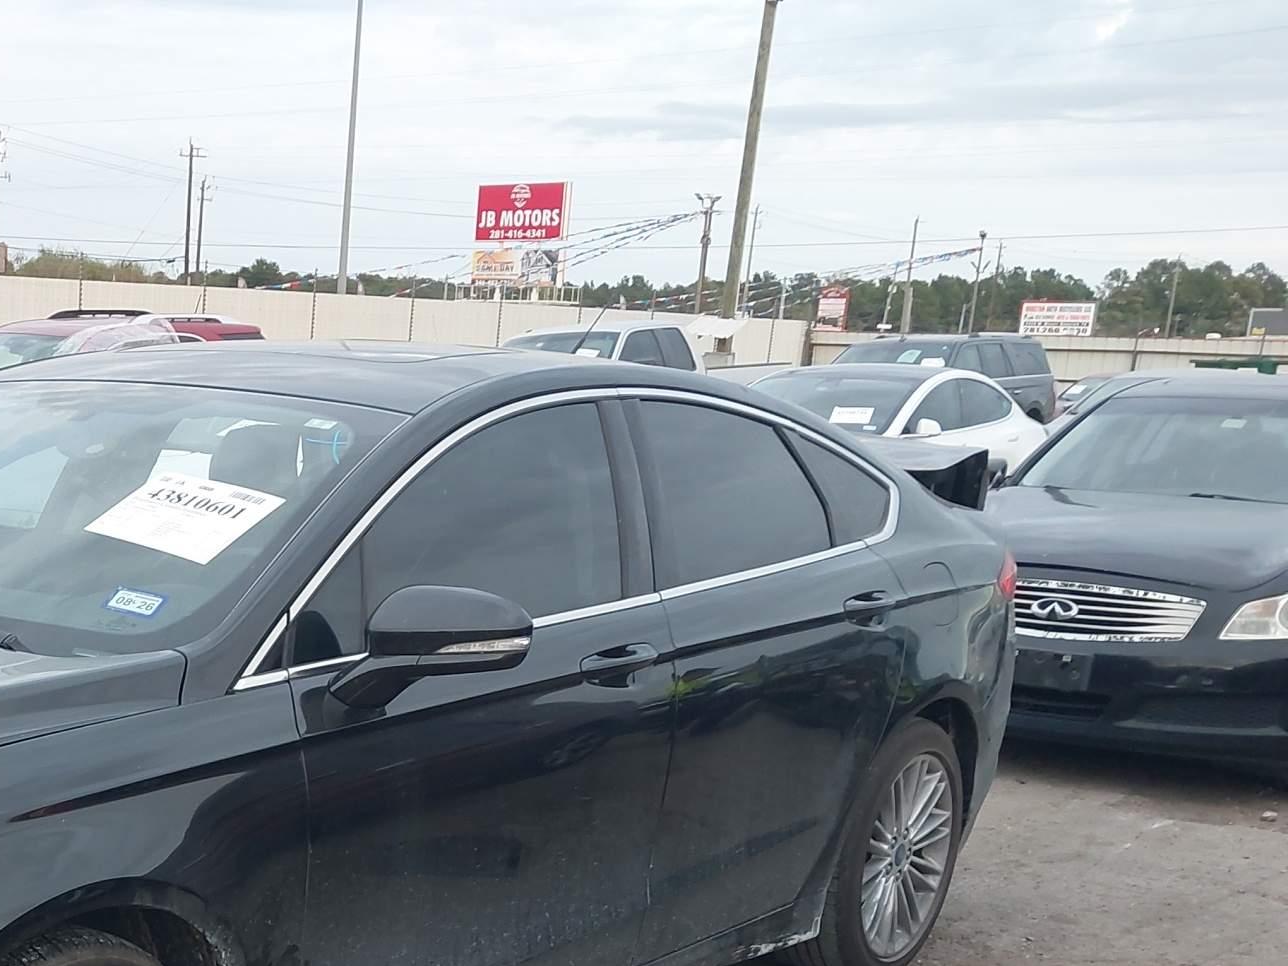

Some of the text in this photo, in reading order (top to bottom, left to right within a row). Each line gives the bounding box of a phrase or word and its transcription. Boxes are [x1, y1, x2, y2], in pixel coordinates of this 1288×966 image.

[479, 208, 560, 228] JB MOTORS
[489, 229, 546, 239] 281-416-4341
[147, 488, 246, 519] 43810601
[115, 596, 133, 606] 08
[136, 600, 155, 611] 26
